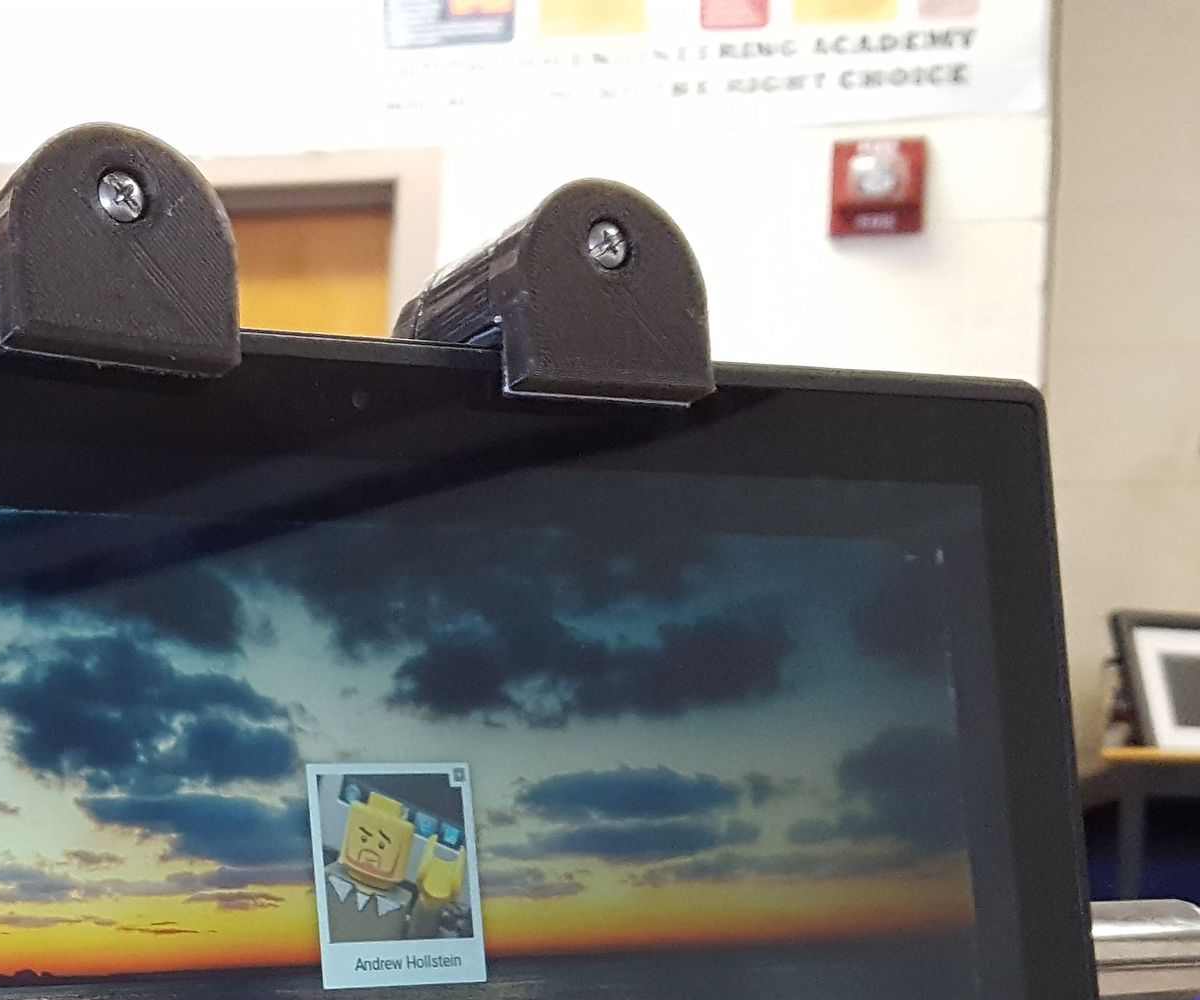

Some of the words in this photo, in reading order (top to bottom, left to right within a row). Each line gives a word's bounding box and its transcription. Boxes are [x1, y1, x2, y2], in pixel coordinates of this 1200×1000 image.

[812, 27, 976, 56] ACADEMY
[838, 61, 972, 91] CHOICE
[355, 957, 402, 971] Andrew
[406, 954, 462, 970] Hollstein
